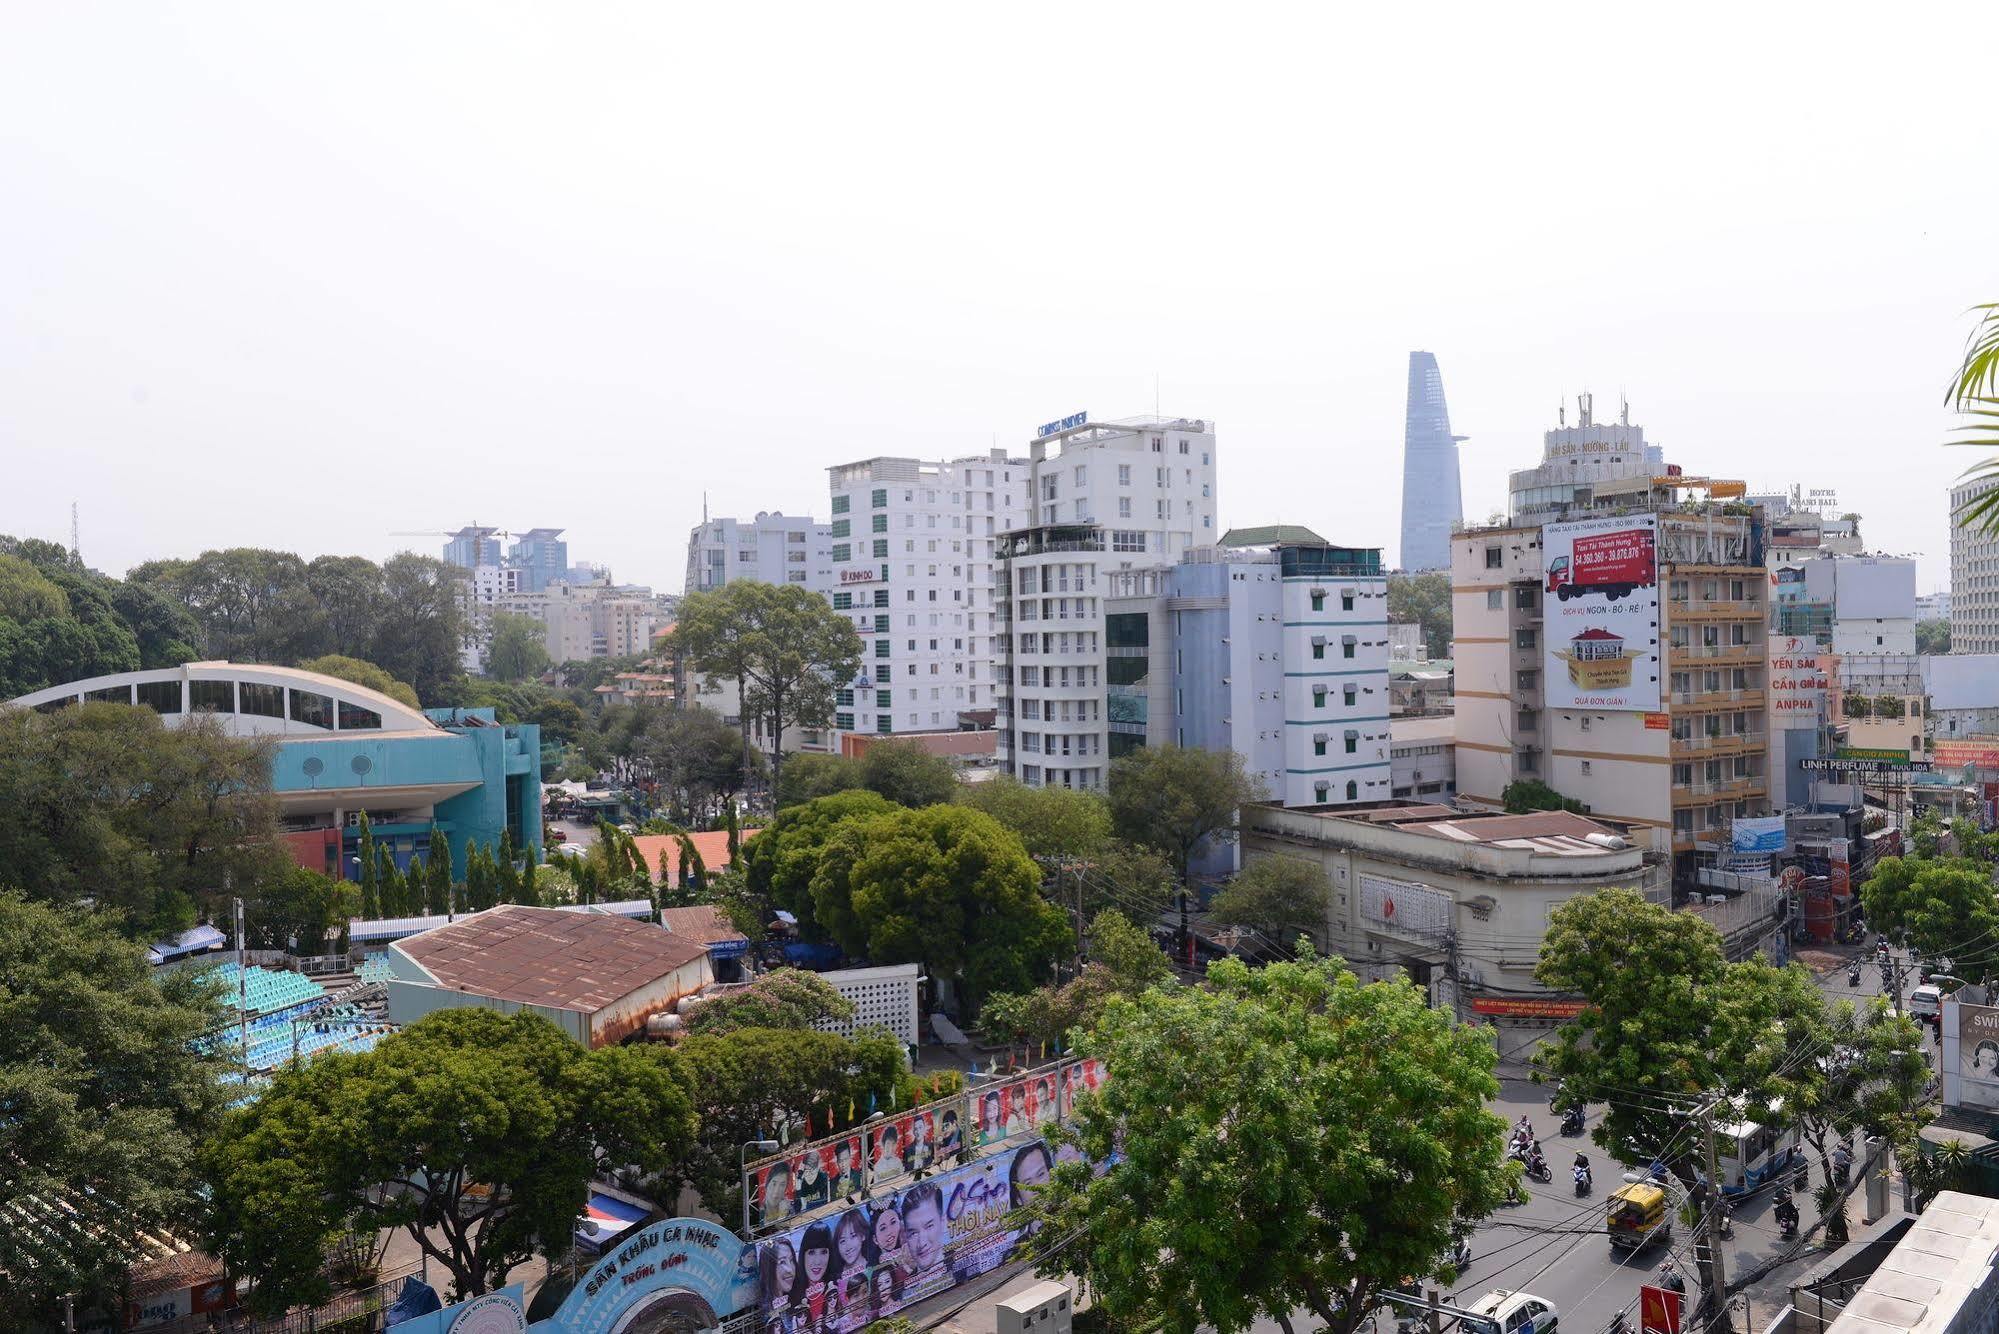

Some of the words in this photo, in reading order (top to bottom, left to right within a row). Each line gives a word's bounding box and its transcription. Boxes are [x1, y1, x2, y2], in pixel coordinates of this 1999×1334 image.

[1586, 605, 1607, 615] NGON
[1772, 656, 1793, 669] YẾN
[1797, 657, 1815, 669] SÀO
[1772, 675, 1796, 690] CẦN
[1775, 699, 1814, 710] ANPHA
[1802, 759, 1828, 770] LINH
[1830, 760, 1879, 772] PERFUME
[1912, 763, 1928, 772] HOA
[585, 1260, 618, 1297] SÂN
[618, 1231, 660, 1267] KHẤU
[663, 1226, 682, 1243] CA
[685, 1226, 721, 1248] NHẠC
[621, 1263, 656, 1286] TRỐNG
